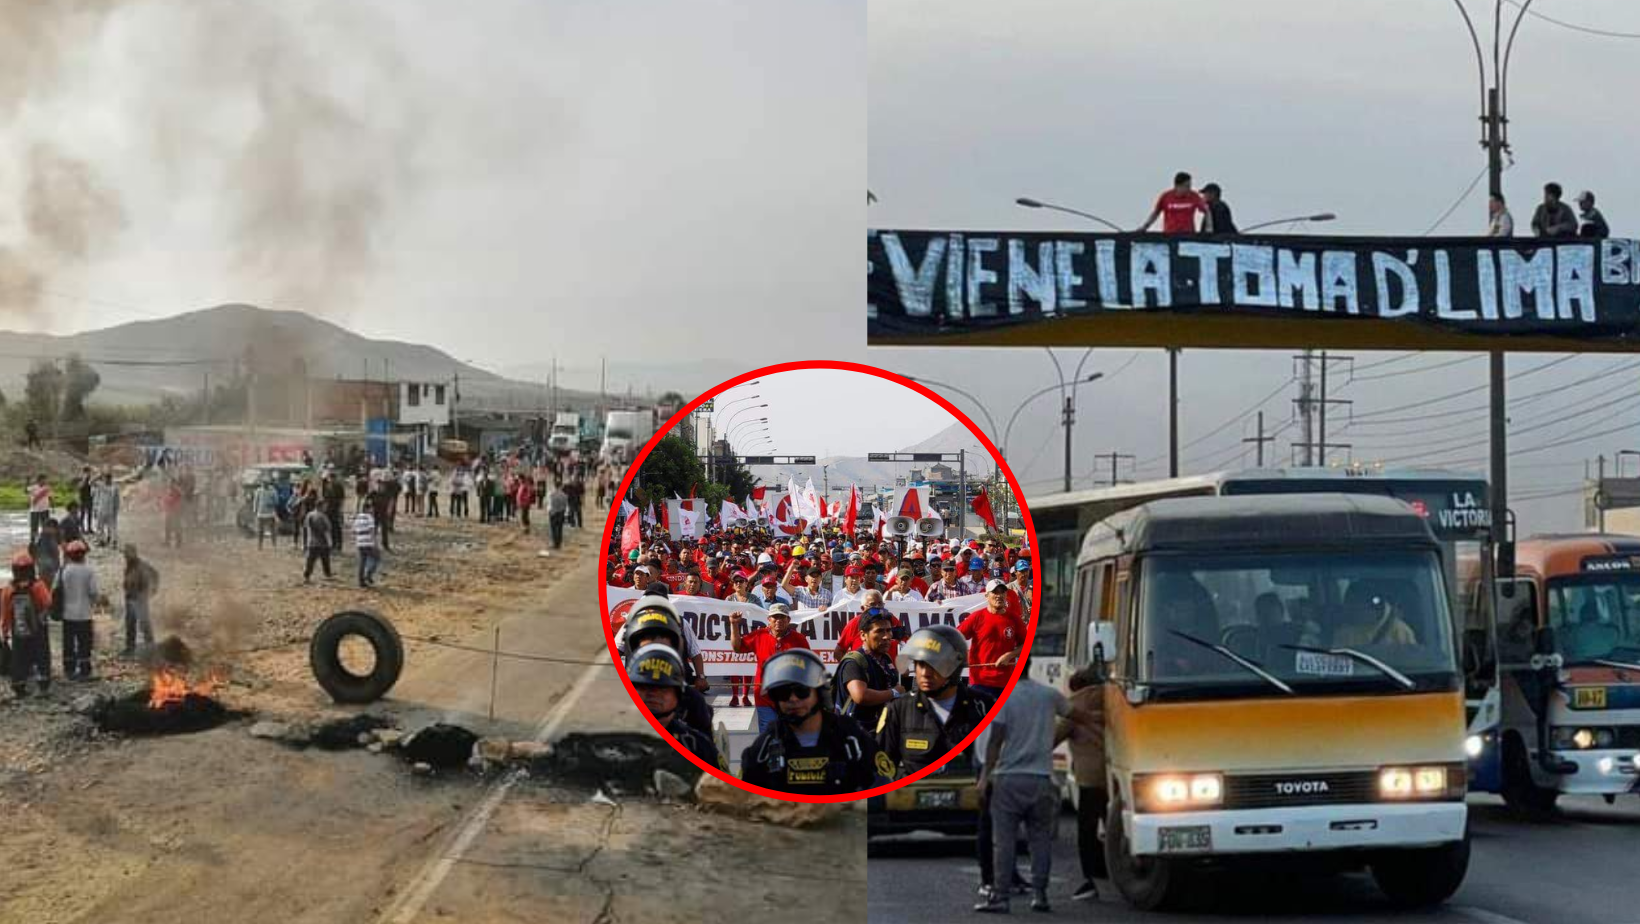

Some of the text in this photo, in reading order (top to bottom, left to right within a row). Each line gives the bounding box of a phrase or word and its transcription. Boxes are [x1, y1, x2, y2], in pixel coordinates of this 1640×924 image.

[881, 234, 1087, 318] VIENE
[1095, 239, 1171, 310] LA
[1178, 241, 1360, 314] TOMA
[1434, 245, 1596, 323] LIMA
[1453, 491, 1476, 508] LA
[639, 657, 673, 677] POLICIA
[1275, 781, 1329, 794] TOYOTA
